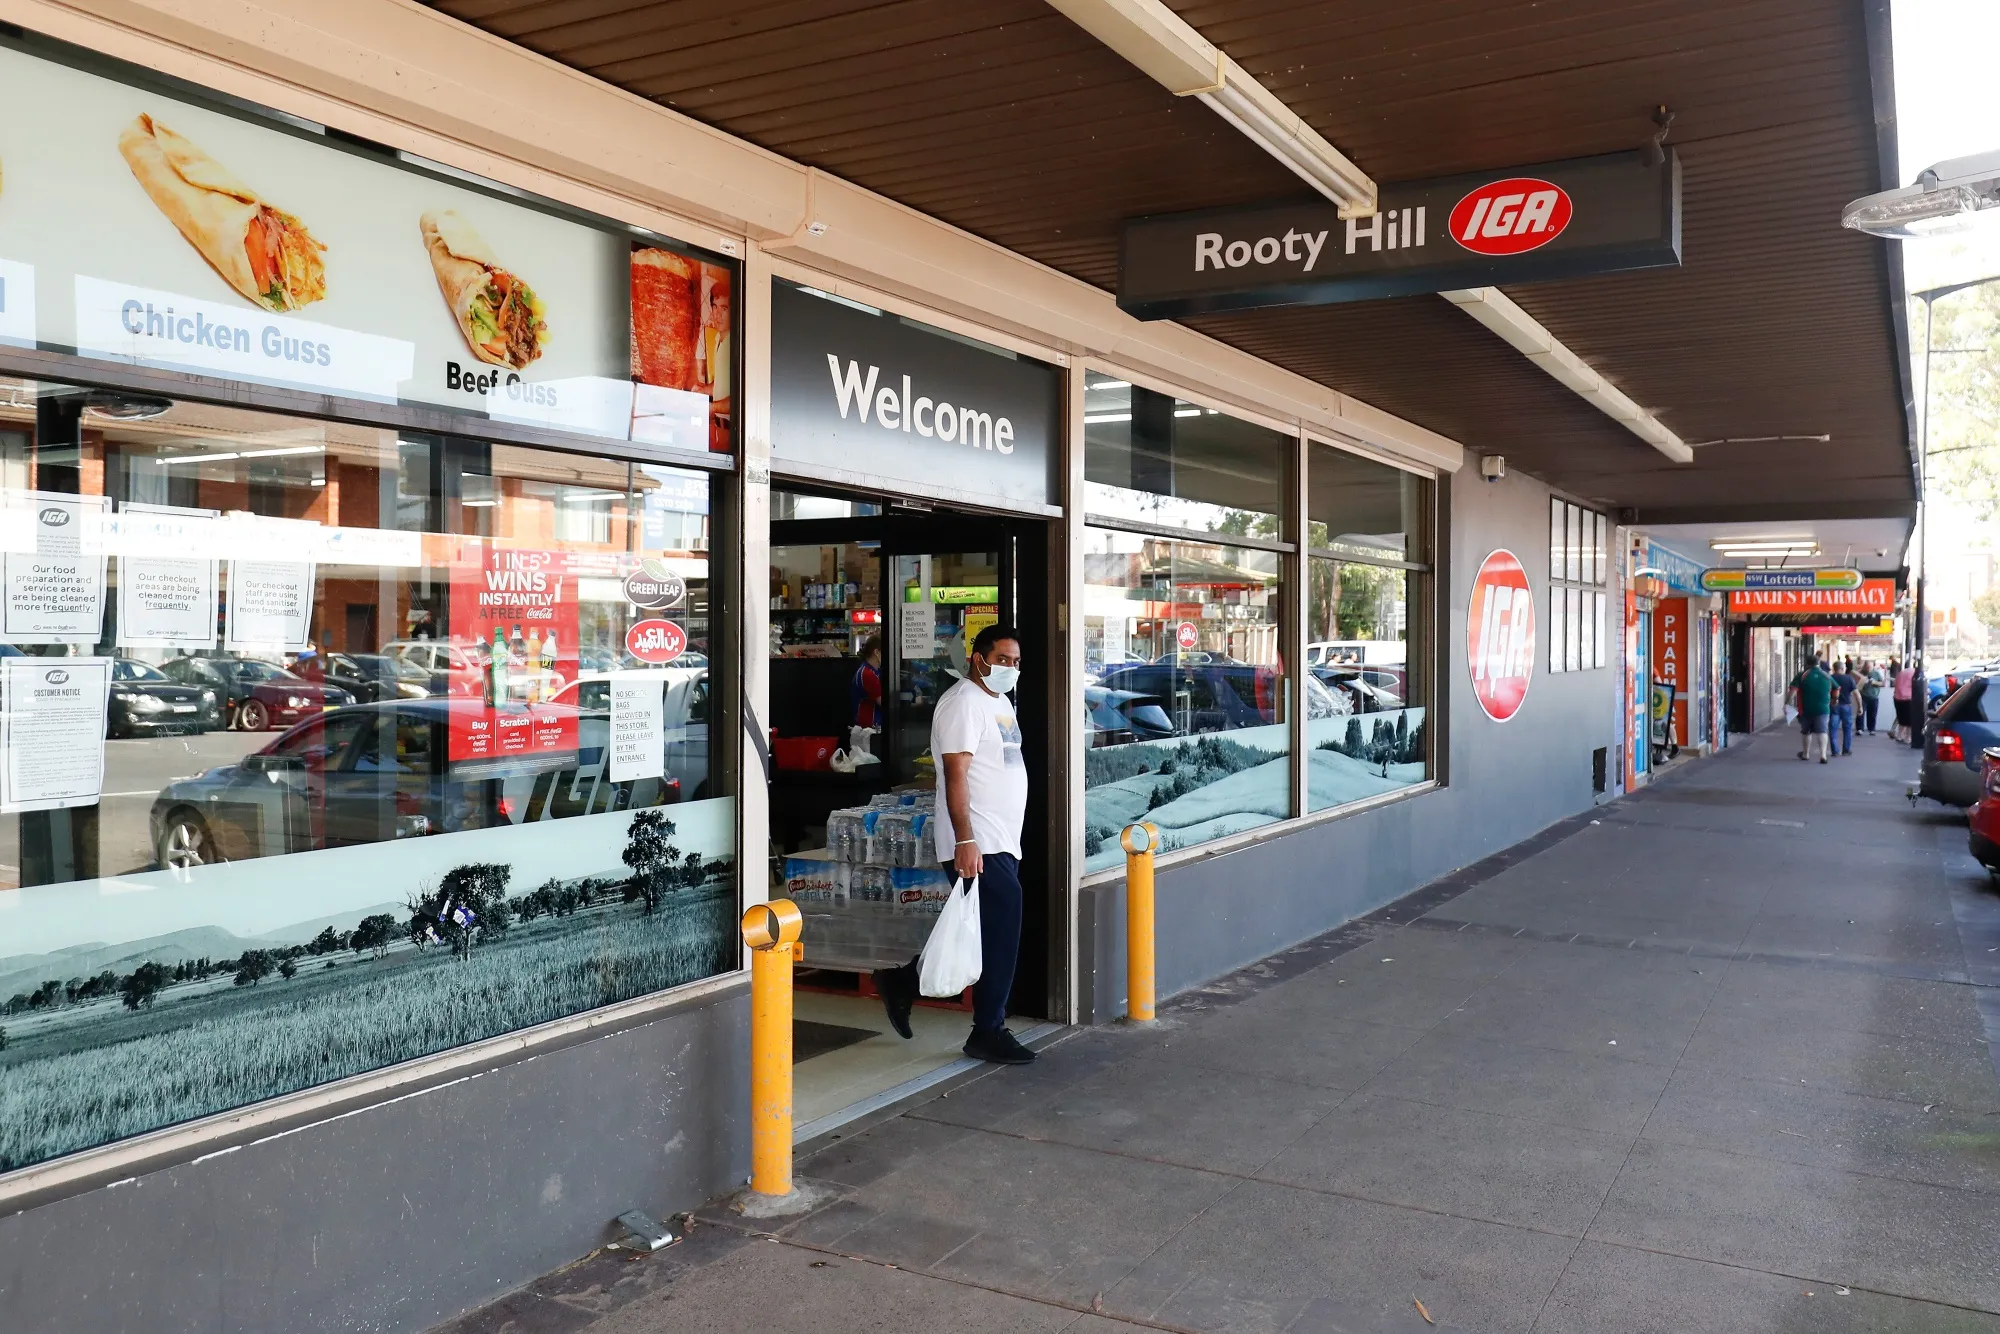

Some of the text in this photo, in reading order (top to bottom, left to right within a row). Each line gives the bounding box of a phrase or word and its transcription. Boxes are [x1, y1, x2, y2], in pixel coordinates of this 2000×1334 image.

[1461, 189, 1560, 241] IGA
[1195, 206, 1426, 272] Rooty Hill
[121, 299, 332, 367] Chicken Guss
[446, 361, 558, 408] Beef Guss
[827, 353, 1014, 455] Welcome
[41, 510, 67, 523] IGA
[492, 552, 500, 569] 1
[506, 552, 524, 570] IN
[32, 564, 76, 574] Our food
[15, 574, 92, 584] preparation and
[138, 572, 197, 584] Our checkout
[485, 570, 547, 592] WINS
[1746, 572, 1813, 586] NSW Lotteries
[23, 583, 85, 593] service areas
[177, 584, 200, 594] being
[245, 580, 298, 591] Our checkout
[629, 581, 680, 597] GREEN LEAF
[31, 593, 58, 603] being
[60, 594, 96, 602] cleaned
[138, 591, 198, 601] cleaned more
[245, 589, 263, 597] staff
[278, 591, 298, 601] using
[479, 592, 553, 606] INSTANTLY
[1735, 587, 1889, 605] LYNCH'S PHARMACY
[14, 603, 41, 611] more
[245, 597, 298, 607] hand sanitiser
[479, 608, 488, 619] A
[490, 608, 523, 619] FREE
[970, 605, 995, 614] SPECIAL
[1475, 584, 1530, 680] IGA
[48, 672, 67, 682] IGA
[33, 688, 81, 697] CUSTOMER NOTICE
[500, 718, 530, 728] Scratch
[542, 716, 558, 724] Win
[472, 721, 488, 731] Buy
[616, 754, 646, 762] ENTRANCE
